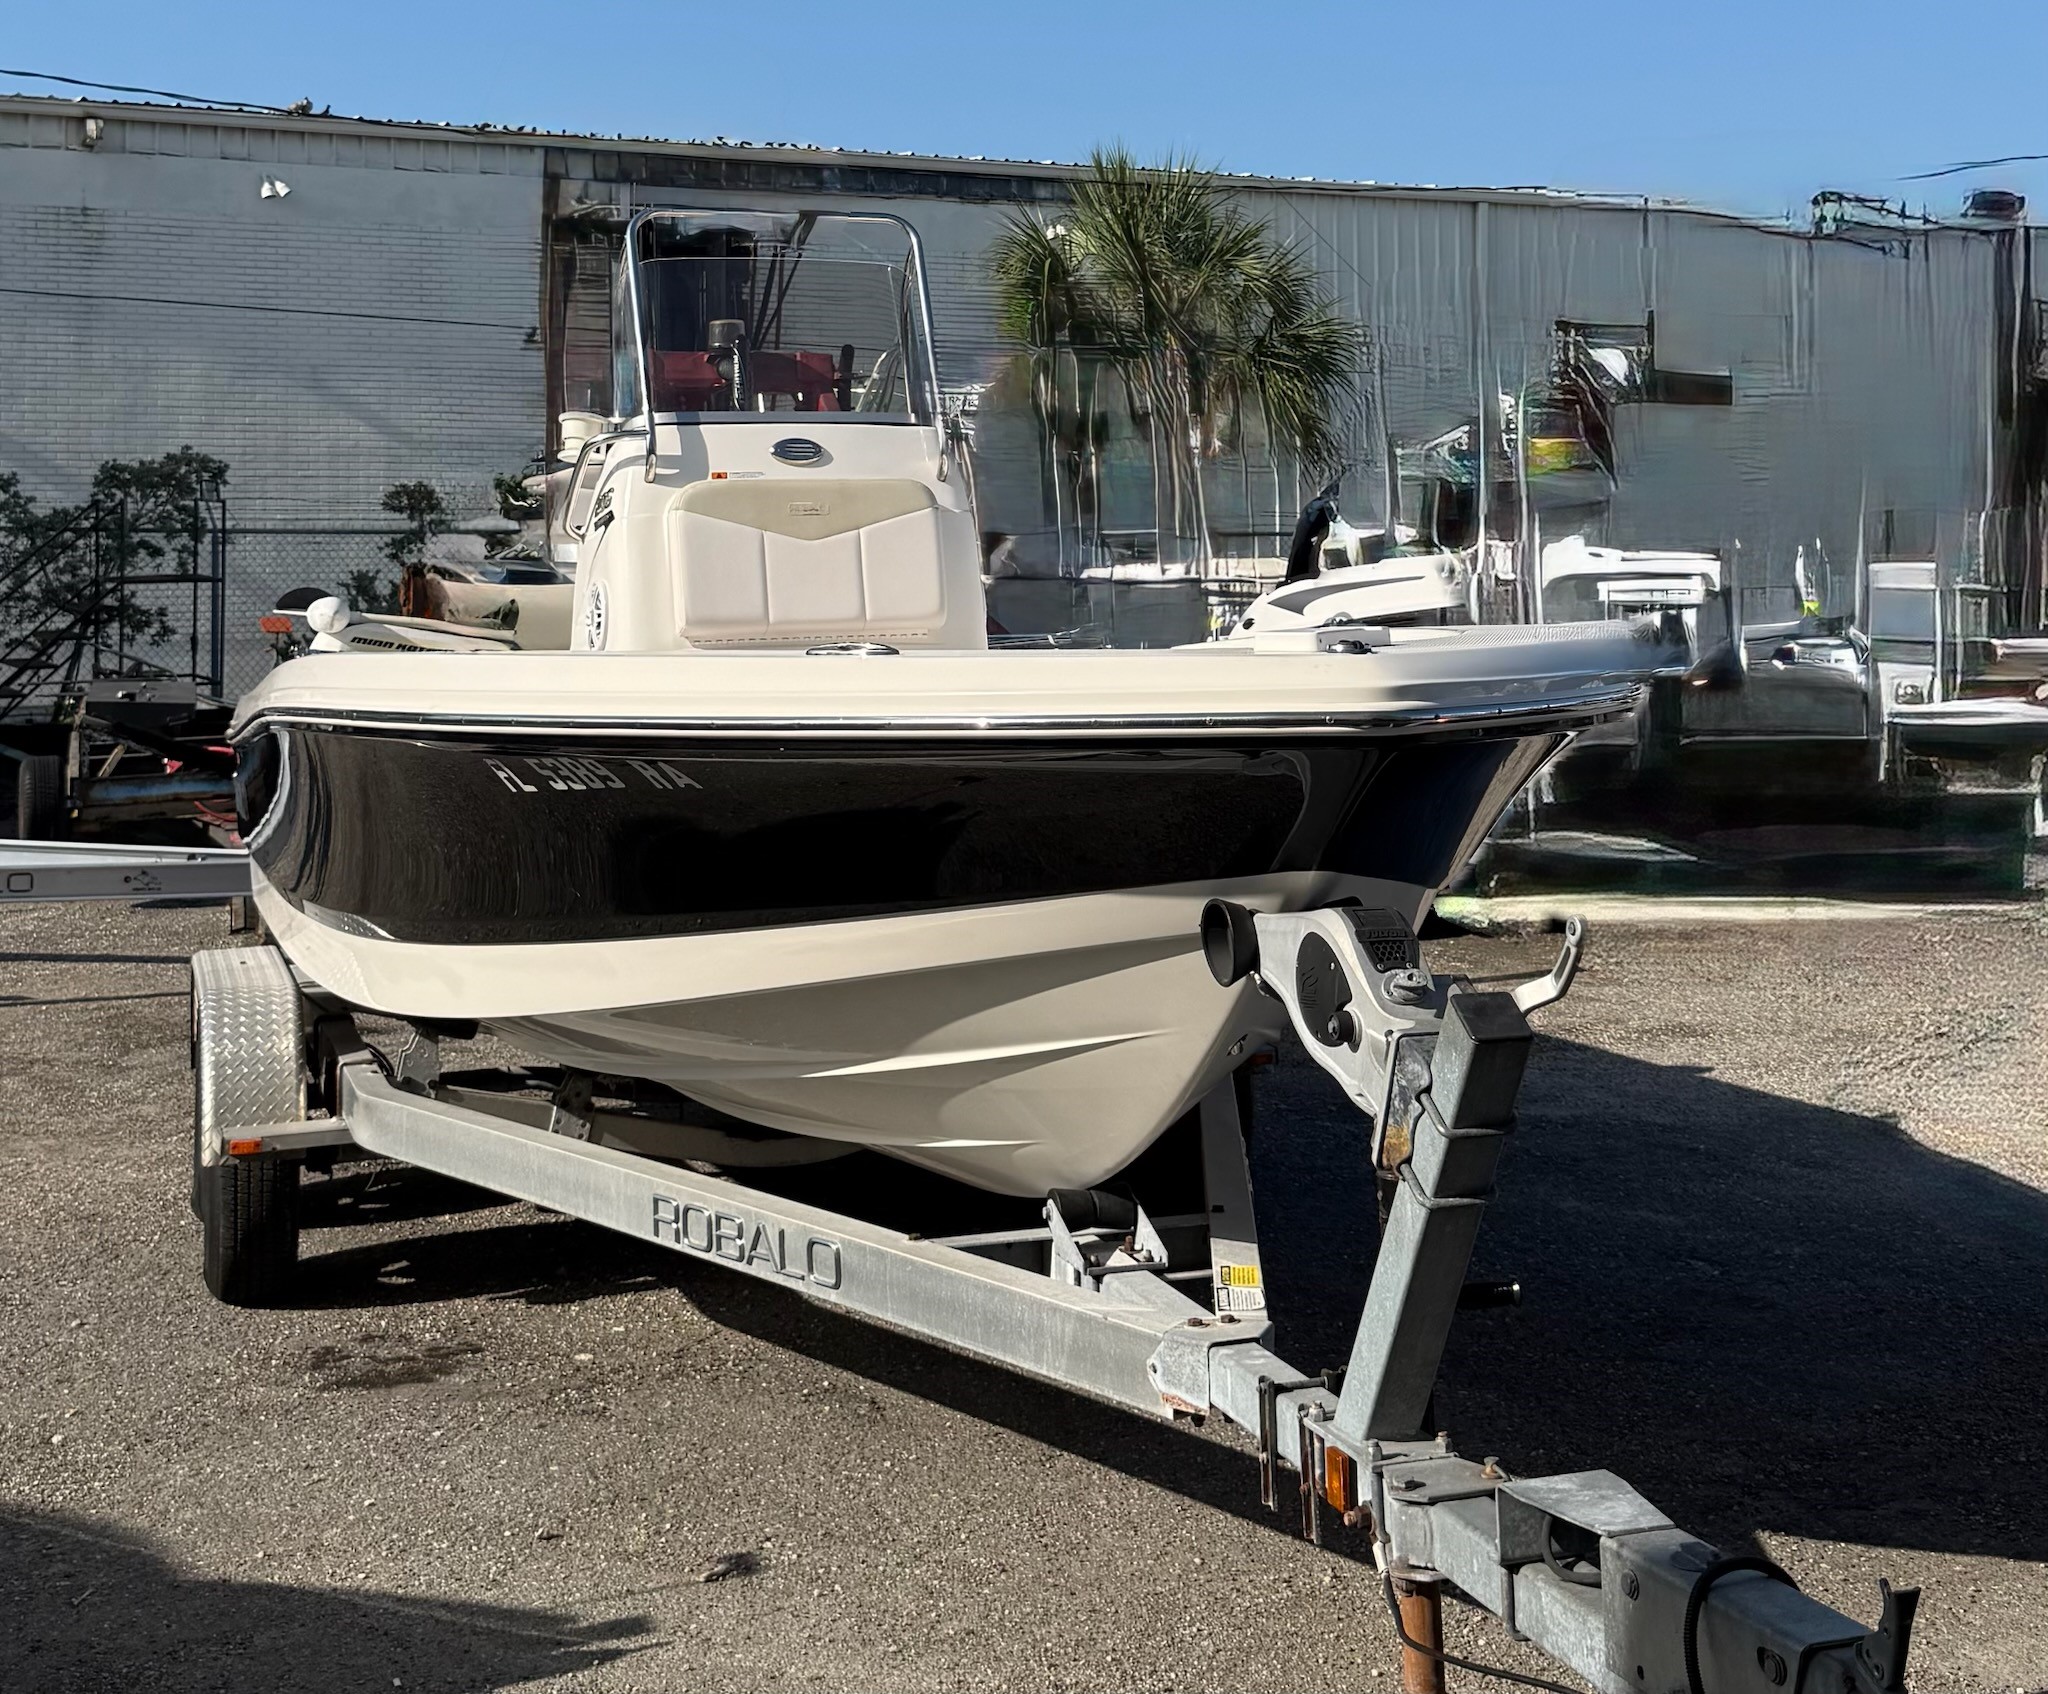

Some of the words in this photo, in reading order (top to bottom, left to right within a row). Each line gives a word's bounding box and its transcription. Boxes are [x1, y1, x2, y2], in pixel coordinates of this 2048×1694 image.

[483, 758, 538, 792] FL
[523, 757, 626, 790] 5389
[652, 1193, 842, 1290] ROBALO
